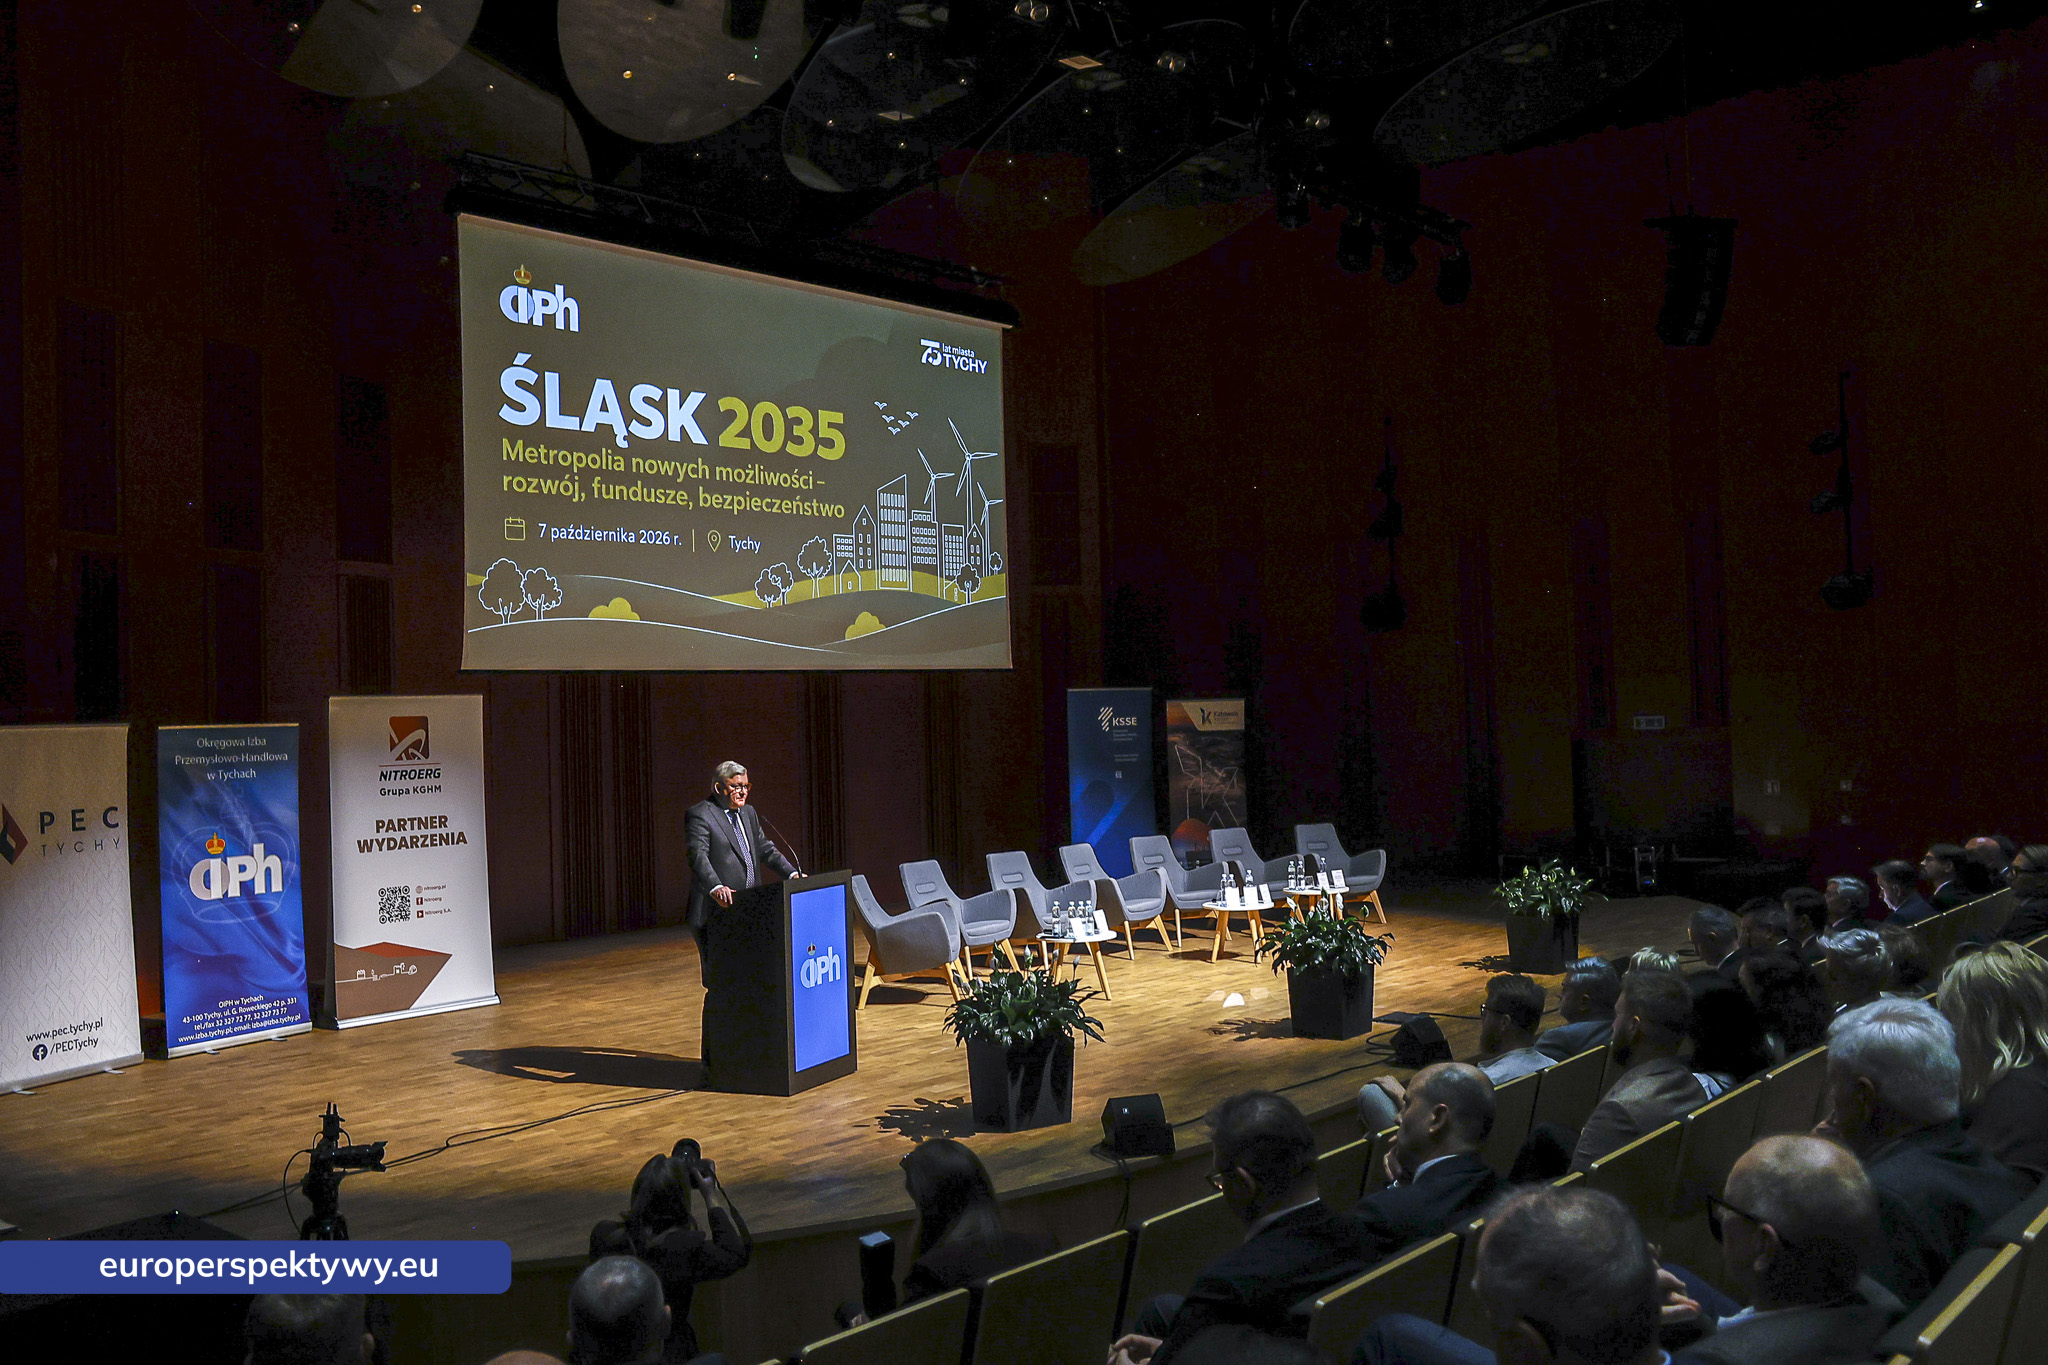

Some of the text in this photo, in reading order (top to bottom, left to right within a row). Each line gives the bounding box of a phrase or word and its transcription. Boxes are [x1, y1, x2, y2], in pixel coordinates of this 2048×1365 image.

[920, 338, 942, 366] 75
[942, 343, 975, 358] lat miasta
[943, 353, 988, 374] TYCHY
[499, 353, 846, 460] ŚLĄSK 2035
[502, 438, 625, 473] Metropolia
[631, 458, 710, 482] nowych
[715, 463, 813, 489] możliwości
[503, 474, 845, 518] rozwój, fundusze, bezpieczeństwo
[538, 522, 761, 554] 7 października 2026 r. Tychy
[1112, 716, 1138, 727] KSSE
[196, 736, 267, 750] Okręgowa Izba
[175, 752, 288, 766] Przemysłowo-Handlowa
[207, 768, 257, 782] w Tychach
[379, 768, 441, 782] NITROERG
[379, 785, 442, 797] Grupa KGHM
[40, 806, 120, 834] PEC
[375, 815, 448, 834] PARTNER
[41, 837, 120, 857] TYCHY
[357, 831, 468, 853] WYDARZENIA
[240, 994, 264, 1005] Tychach
[182, 1014, 204, 1024] 43-100
[287, 997, 297, 1005] 331
[215, 1019, 223, 1027] 32
[224, 1017, 234, 1026] 327
[236, 1015, 243, 1023] 72
[253, 1012, 261, 1020] 32
[261, 1010, 271, 1018] 327
[26, 1017, 103, 1042] www.pec.tychy.pl
